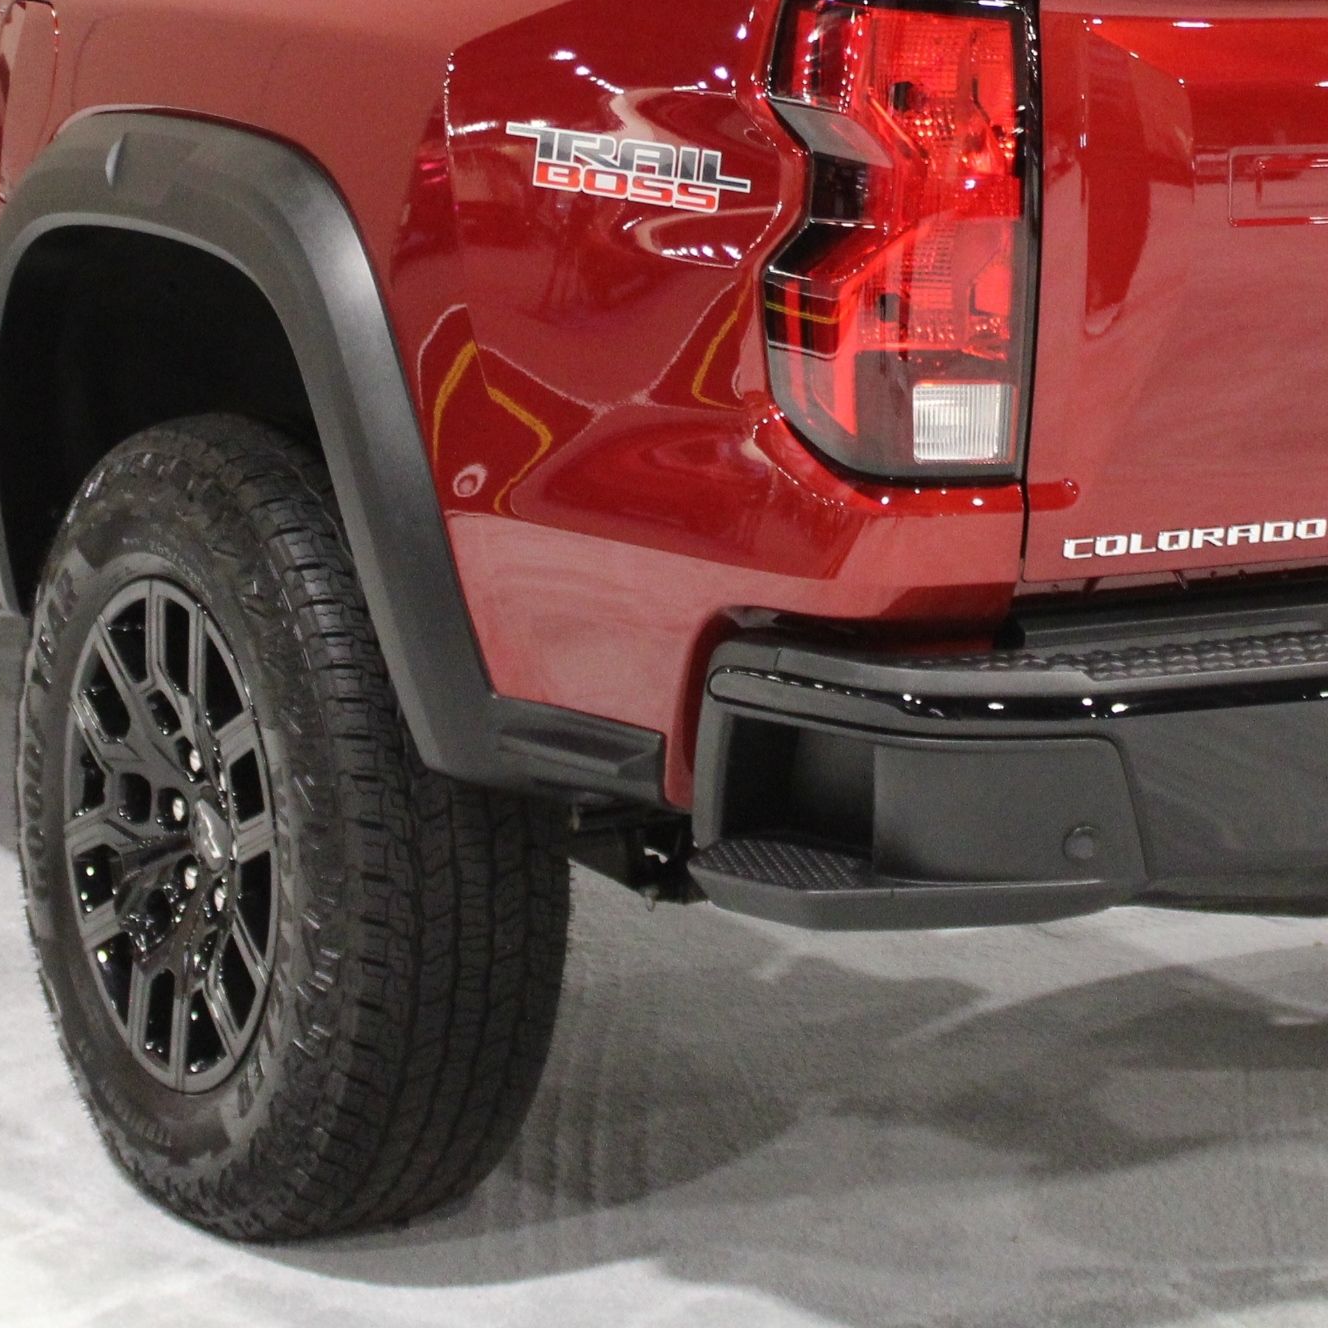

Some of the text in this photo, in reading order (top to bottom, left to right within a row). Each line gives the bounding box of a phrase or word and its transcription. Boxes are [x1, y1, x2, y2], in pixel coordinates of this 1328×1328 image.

[505, 121, 752, 194] TRAIL
[533, 160, 720, 214] BOSS
[1062, 517, 1328, 562] COLORADO
